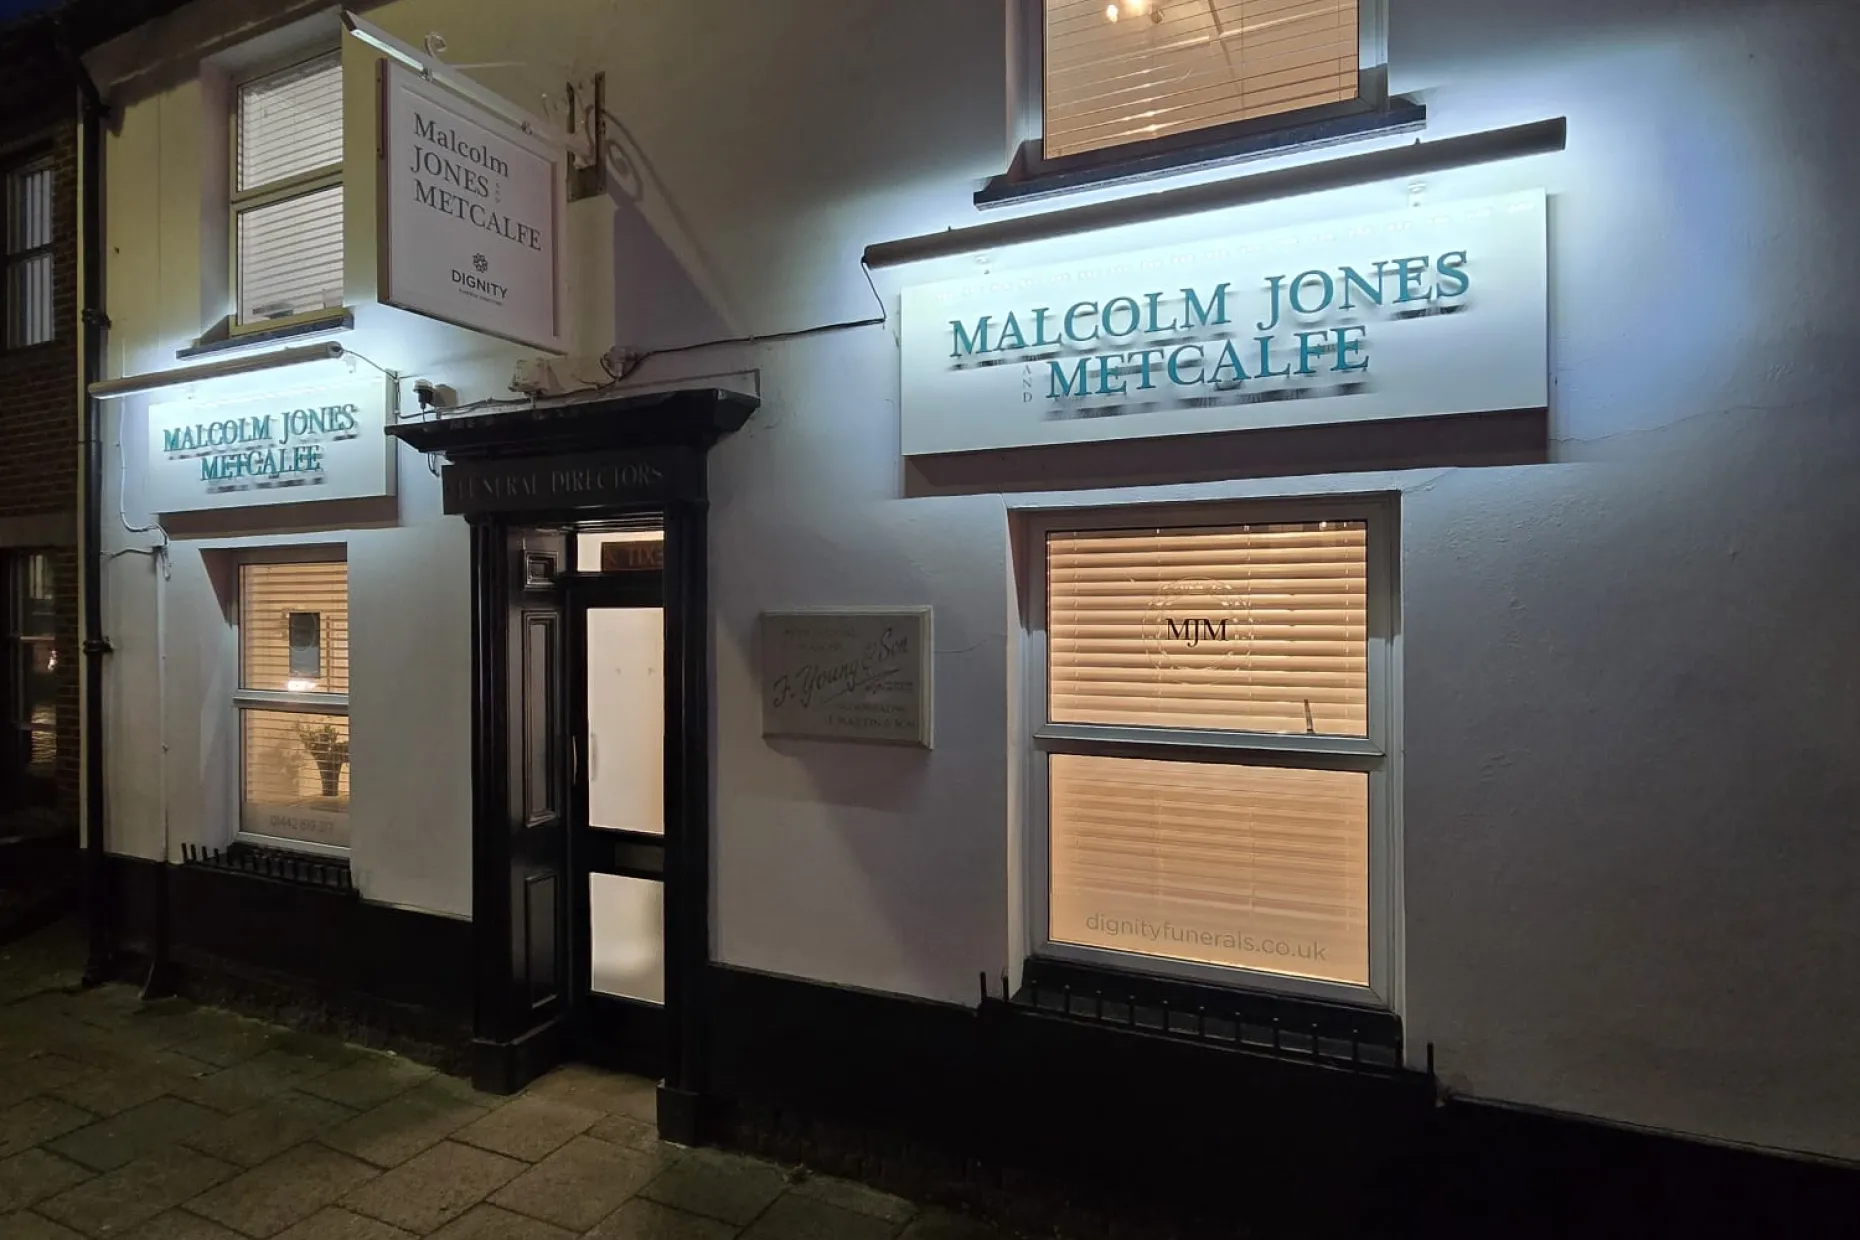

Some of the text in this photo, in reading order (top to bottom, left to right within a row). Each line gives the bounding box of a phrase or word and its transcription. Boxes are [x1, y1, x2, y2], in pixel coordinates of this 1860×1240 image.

[414, 112, 509, 178] Malcolm
[410, 146, 489, 198] JONES
[414, 179, 542, 251] METCALFE
[452, 269, 508, 299] DIGNITY
[949, 250, 1471, 358] MALCOLM JONES
[1046, 325, 1370, 400] METCALFE
[163, 404, 357, 452] MALCOLM JONES
[201, 445, 322, 481] METCALFE
[552, 464, 664, 494] DIRECTORS
[1166, 618, 1230, 647] MJM
[1086, 913, 1328, 962] dignityfunerals.co.uk
